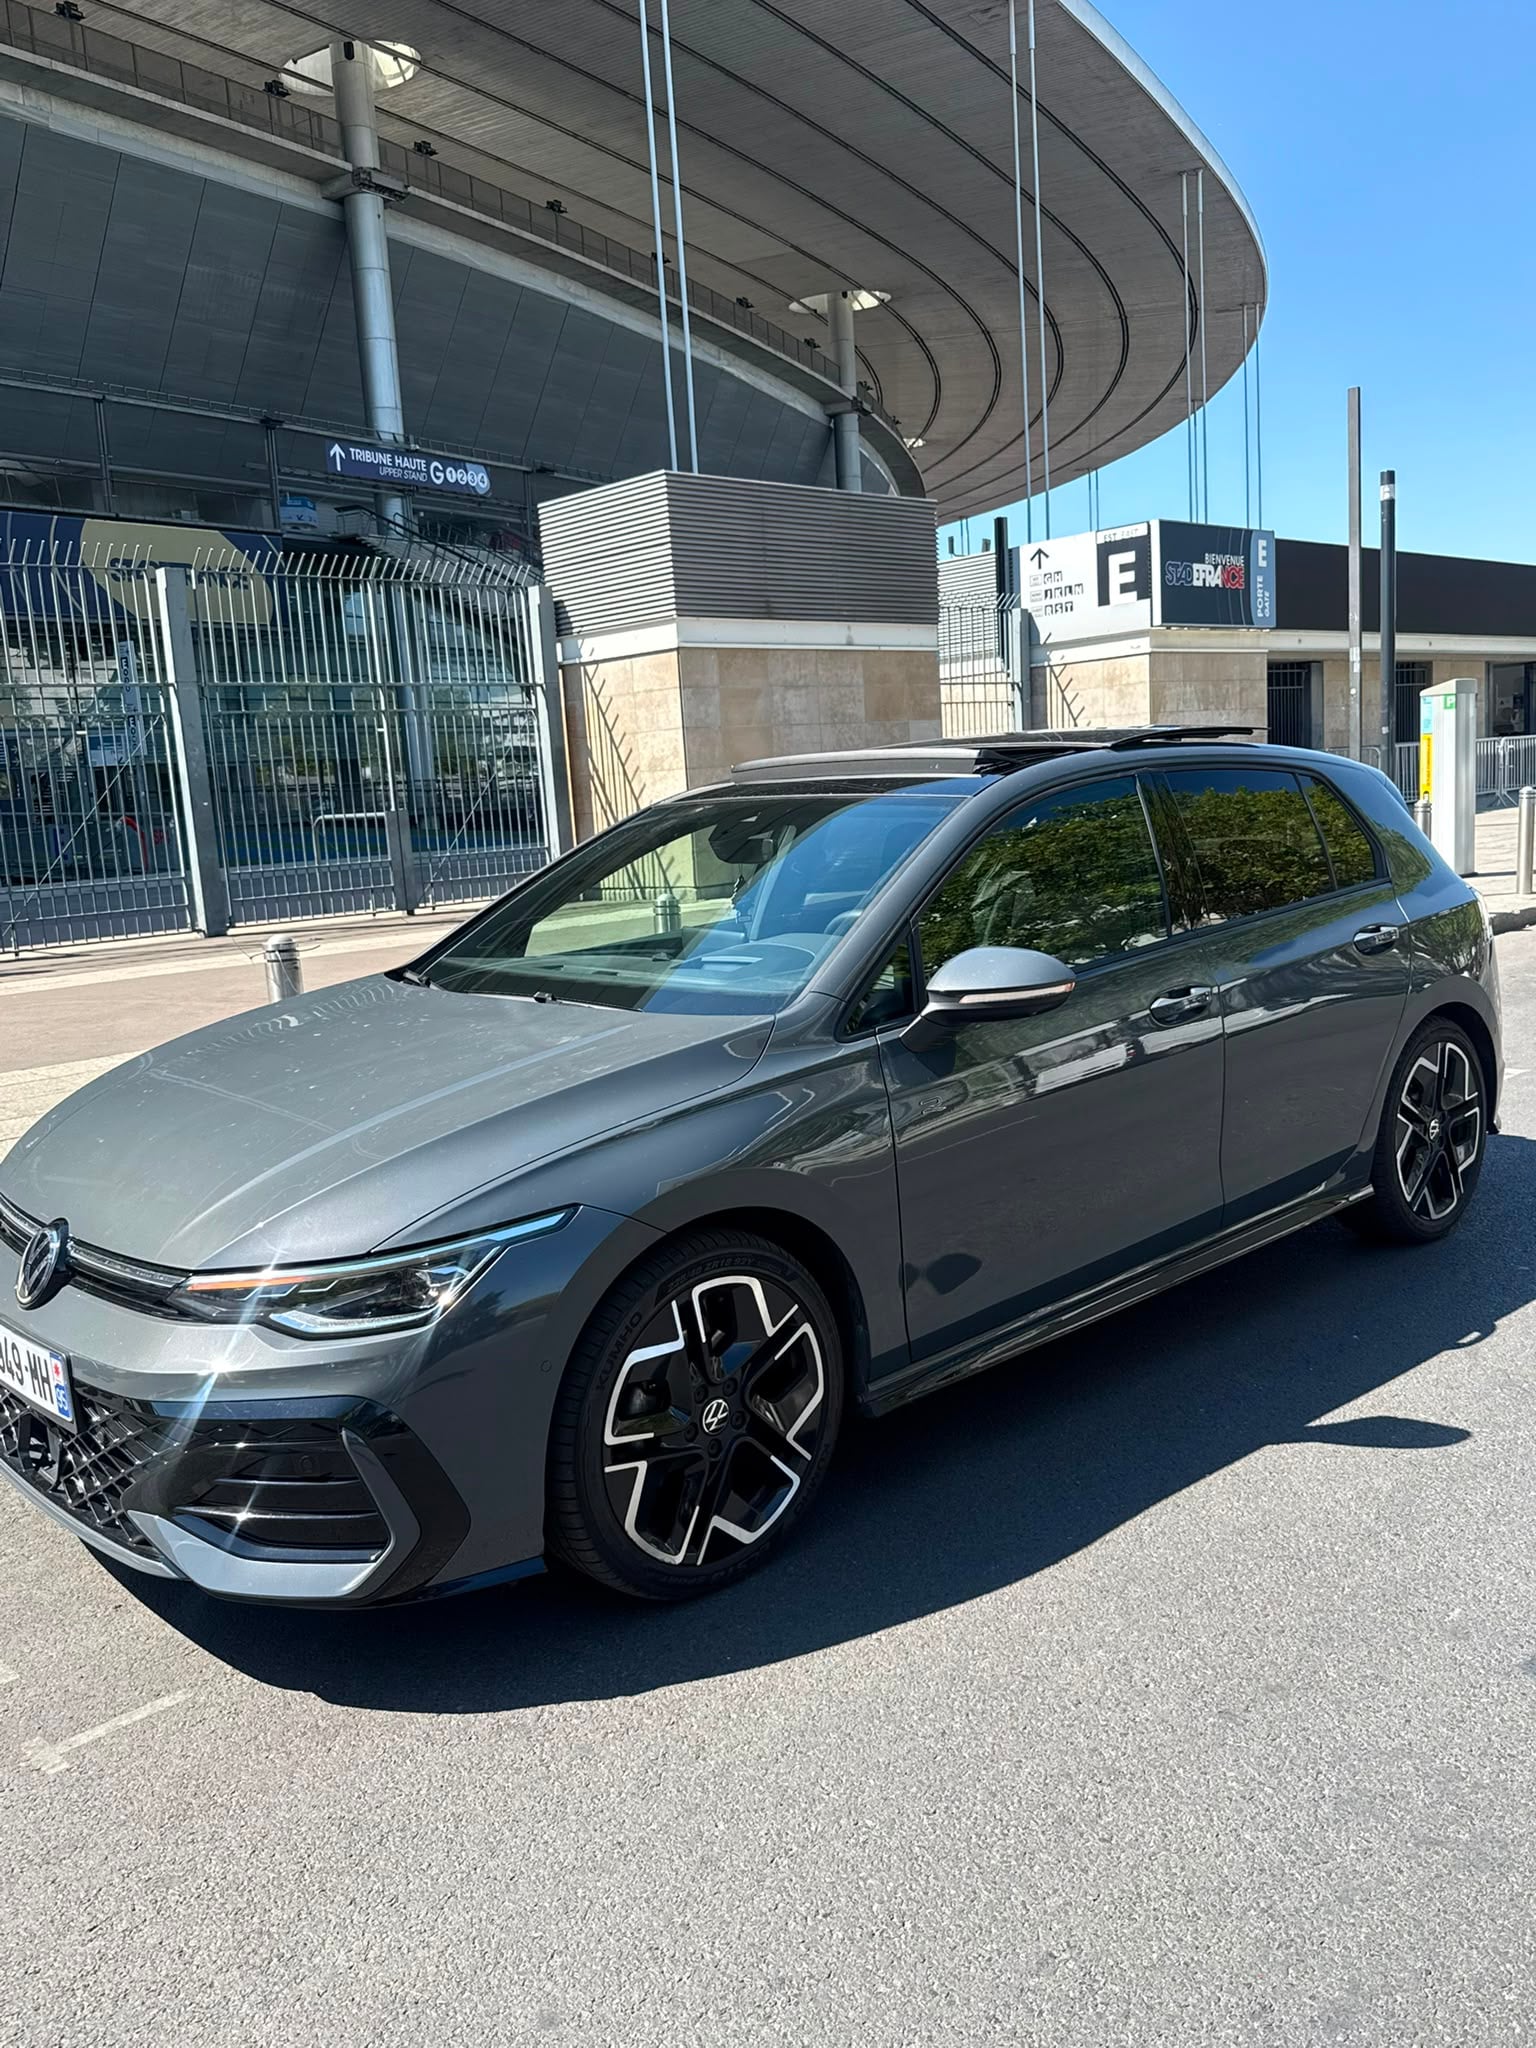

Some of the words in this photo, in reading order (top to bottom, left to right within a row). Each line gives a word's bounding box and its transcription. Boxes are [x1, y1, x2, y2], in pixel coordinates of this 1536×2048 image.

[350, 448, 392, 467] TRIBUNE
[394, 455, 427, 472] HAUTE
[379, 466, 402, 479] UPPER
[403, 470, 428, 482] STAND
[430, 461, 445, 485] G
[1205, 553, 1245, 567] BIENVENUE
[1258, 539, 1267, 567] E
[1108, 551, 1137, 605] E
[597, 1311, 643, 1391] KUMHO
